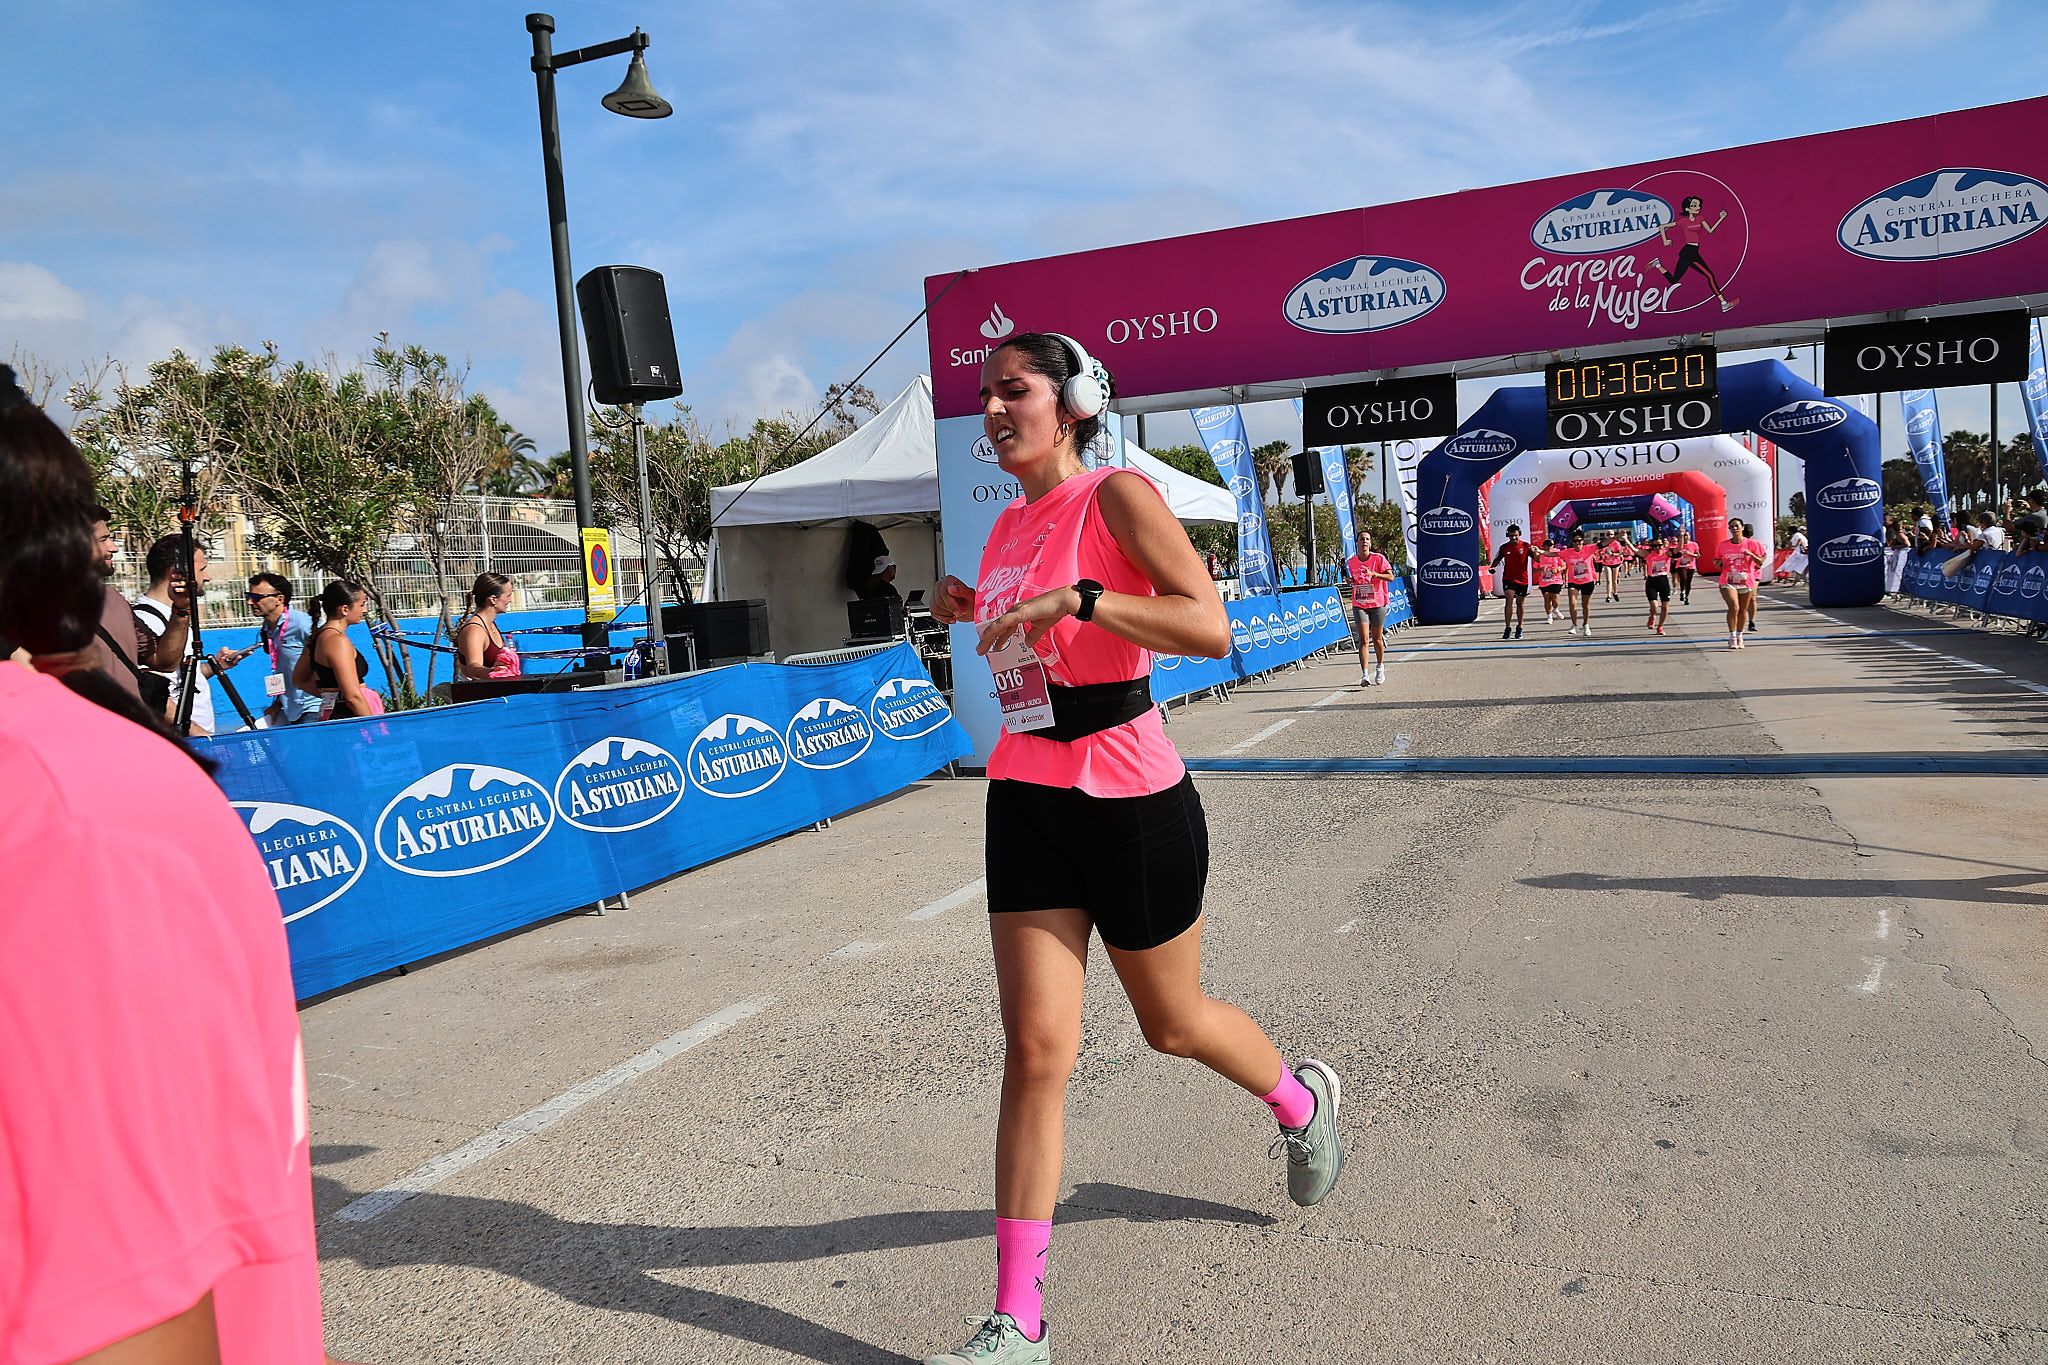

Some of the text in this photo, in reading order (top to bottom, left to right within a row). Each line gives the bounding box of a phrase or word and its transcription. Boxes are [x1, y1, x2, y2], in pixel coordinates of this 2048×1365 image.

[1563, 203, 1658, 223] CENTRAL LECHERA
[1887, 188, 2032, 217] CENTRAL LECHERA
[1541, 212, 1662, 245] ASTURIANA
[1854, 201, 2040, 246] ASTURIANA
[1319, 275, 1427, 295] CENTRAL LECHERA
[1520, 255, 1636, 290] Carrera
[1295, 285, 1433, 320] ASTURIANA
[1548, 273, 1682, 329] de la Mujer
[1106, 307, 1218, 344] OYSHO
[1856, 336, 1999, 372] OYSHO
[1557, 353, 1705, 401] 00:36:20
[1327, 397, 1433, 428] OYSHO
[1555, 400, 1712, 442] OYSHO
[1766, 411, 1842, 430] ASTURIANA
[1449, 441, 1511, 454] ASTURIANA
[1568, 442, 1680, 470] OYSHO
[1714, 458, 1750, 468] OYSHO
[972, 483, 1024, 503] OYSH
[1505, 476, 1538, 486] OYSHO
[1568, 473, 1666, 489] Sports Santander
[1733, 501, 1768, 511] OYSHO
[1821, 490, 1879, 504] ASTURIANA
[1422, 519, 1470, 529] ASTURIANA
[1493, 518, 1523, 527] OYSHO
[1822, 546, 1881, 559] ASTURIANA
[1422, 569, 1470, 580] ASTURIANA
[995, 668, 1024, 691] 016
[884, 688, 938, 709] CENTRAL LECHER
[803, 720, 832, 734] CENTRAL
[708, 734, 774, 756] CENTRAL LECHERA
[795, 722, 869, 759] ASTURIANA
[585, 759, 669, 784] CENTRAL LECHERA
[698, 745, 783, 785] ASTURIANA
[416, 788, 534, 821] CENTRAL LECHERA
[570, 771, 680, 818] ASTURIANA
[262, 827, 338, 853] LECHERA
[395, 802, 546, 861] ASTURIANA
